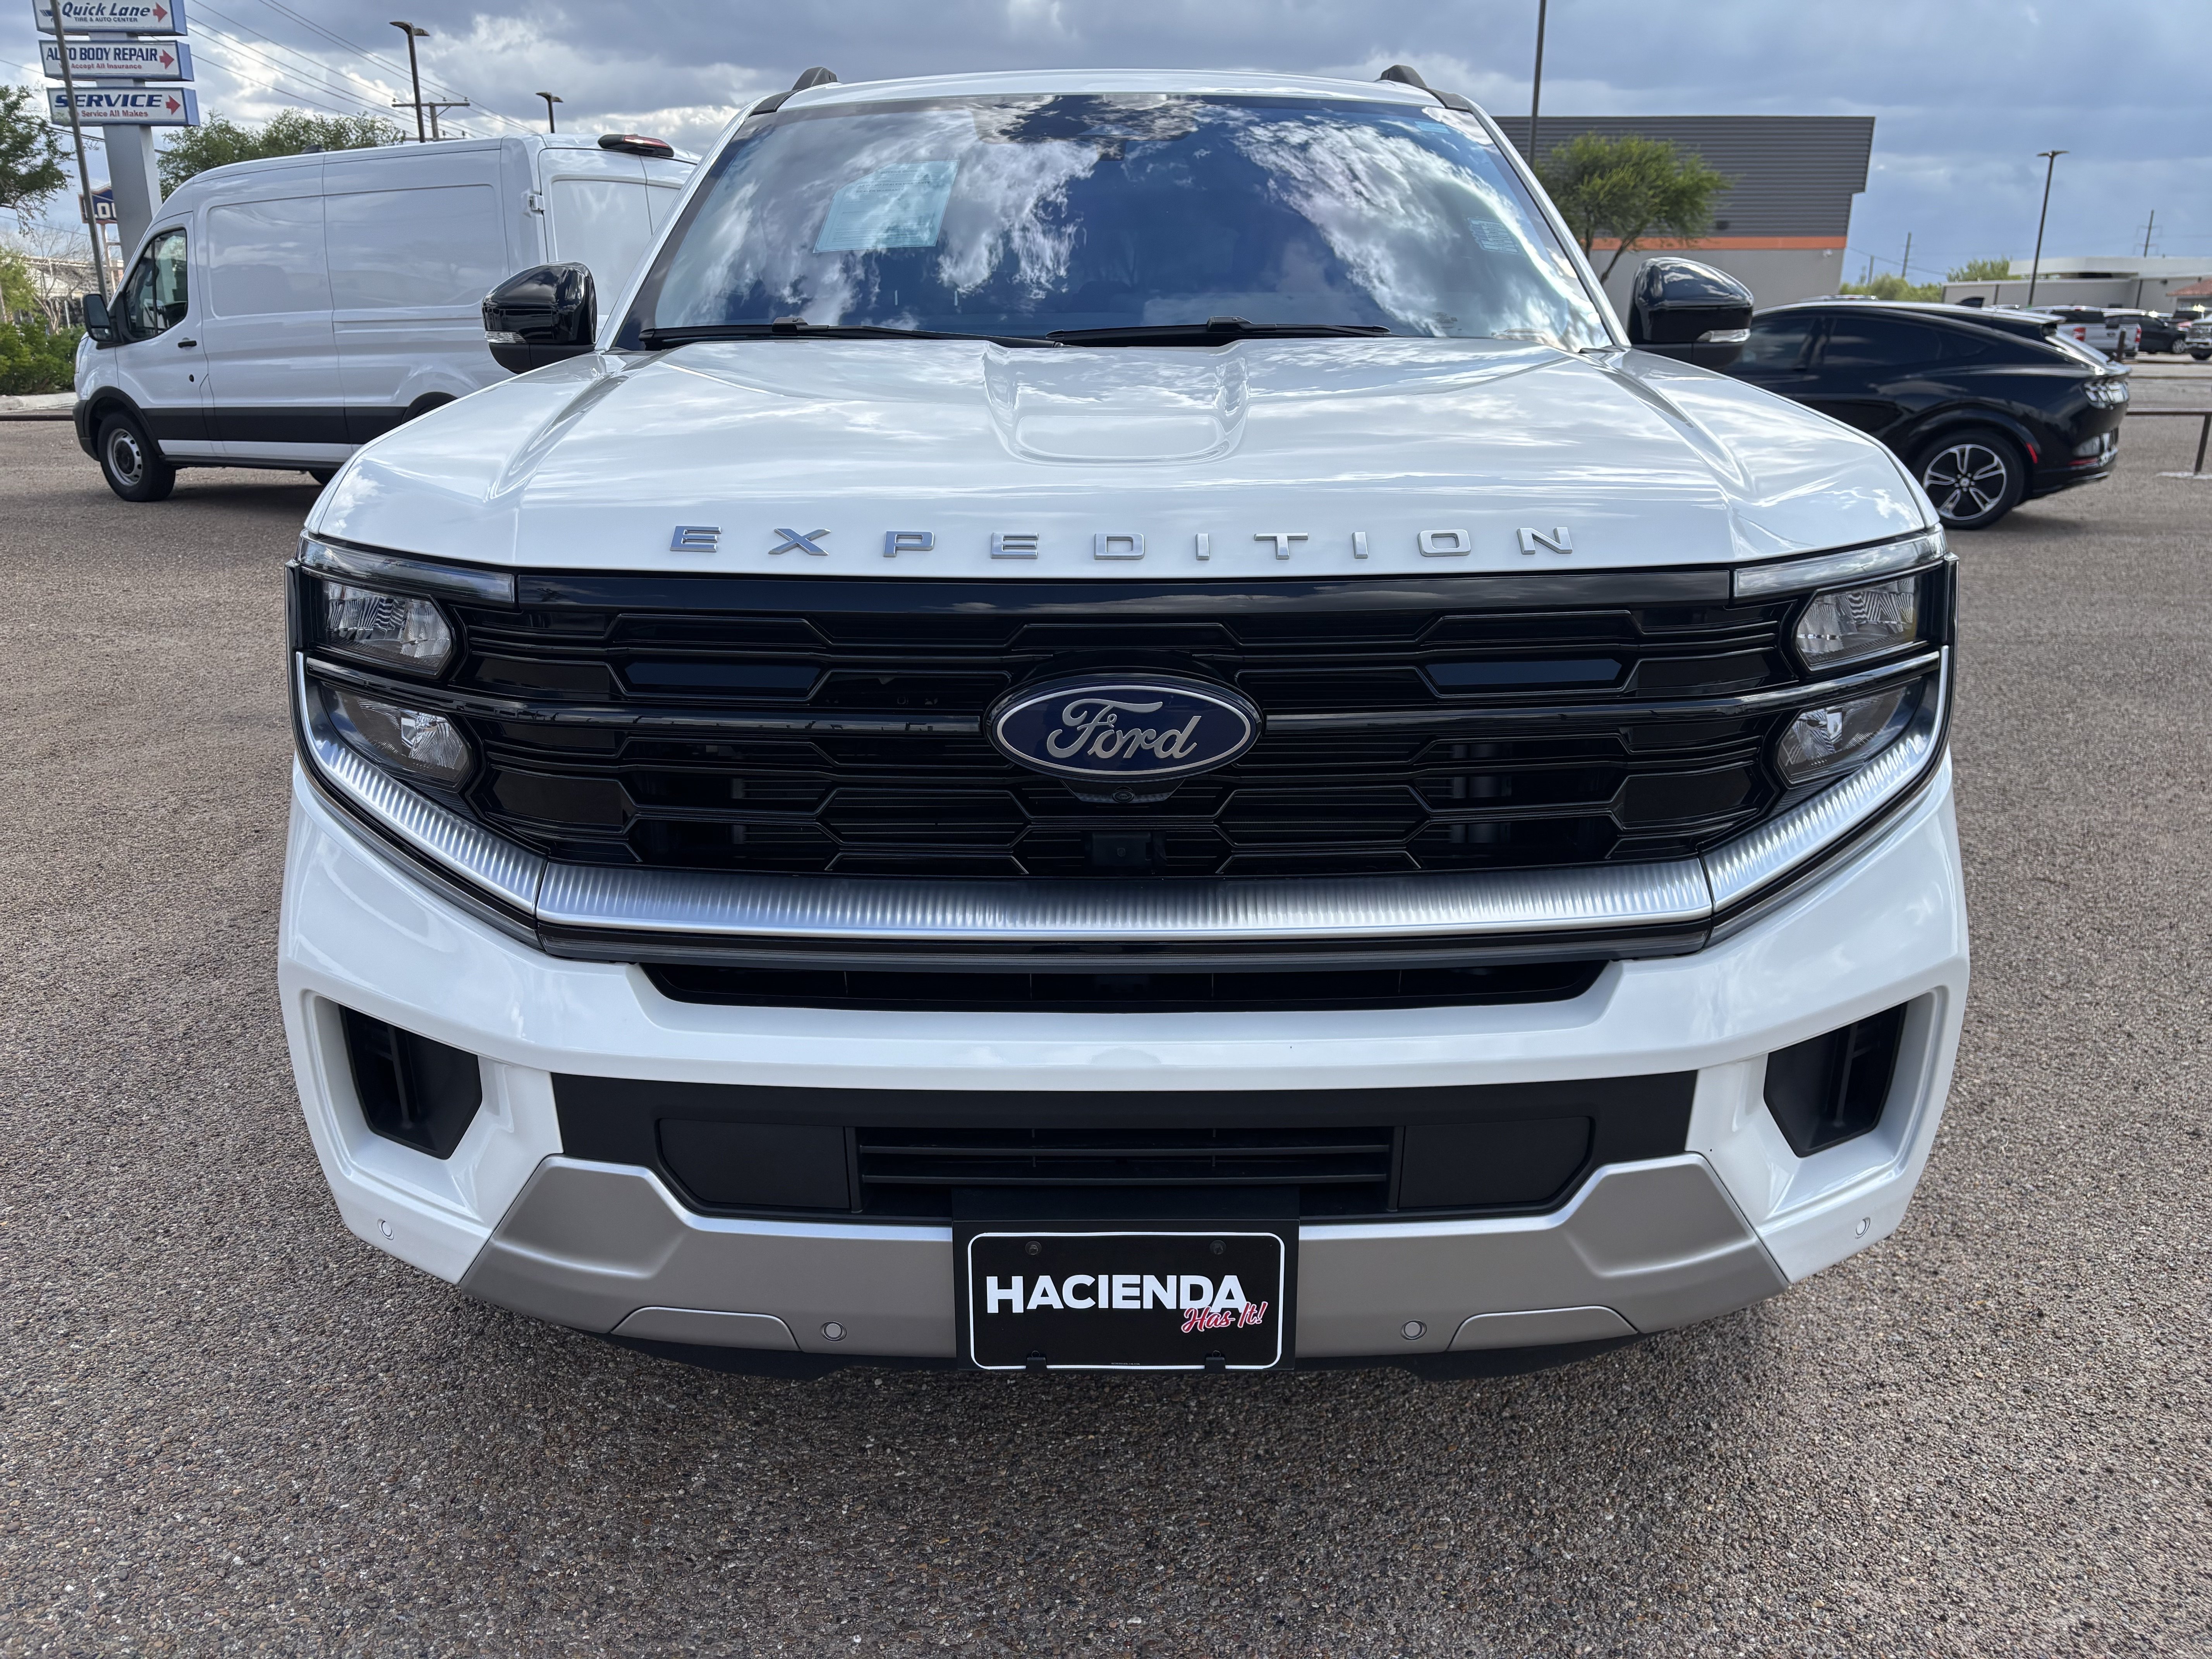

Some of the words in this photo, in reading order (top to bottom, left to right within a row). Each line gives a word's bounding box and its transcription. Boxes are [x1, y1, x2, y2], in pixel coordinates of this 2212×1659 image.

[62, 2, 106, 17] Quick
[109, 3, 150, 16] Lane
[46, 47, 76, 60] AUO
[79, 47, 110, 60] BODY
[113, 48, 158, 61] REPAIR
[670, 526, 1573, 560] EXPEDITION
[1047, 698, 1201, 759] Ford
[986, 1274, 1247, 1314] HACIENDA
[1181, 1306, 1235, 1333] Has
[1237, 1301, 1268, 1328] It!
